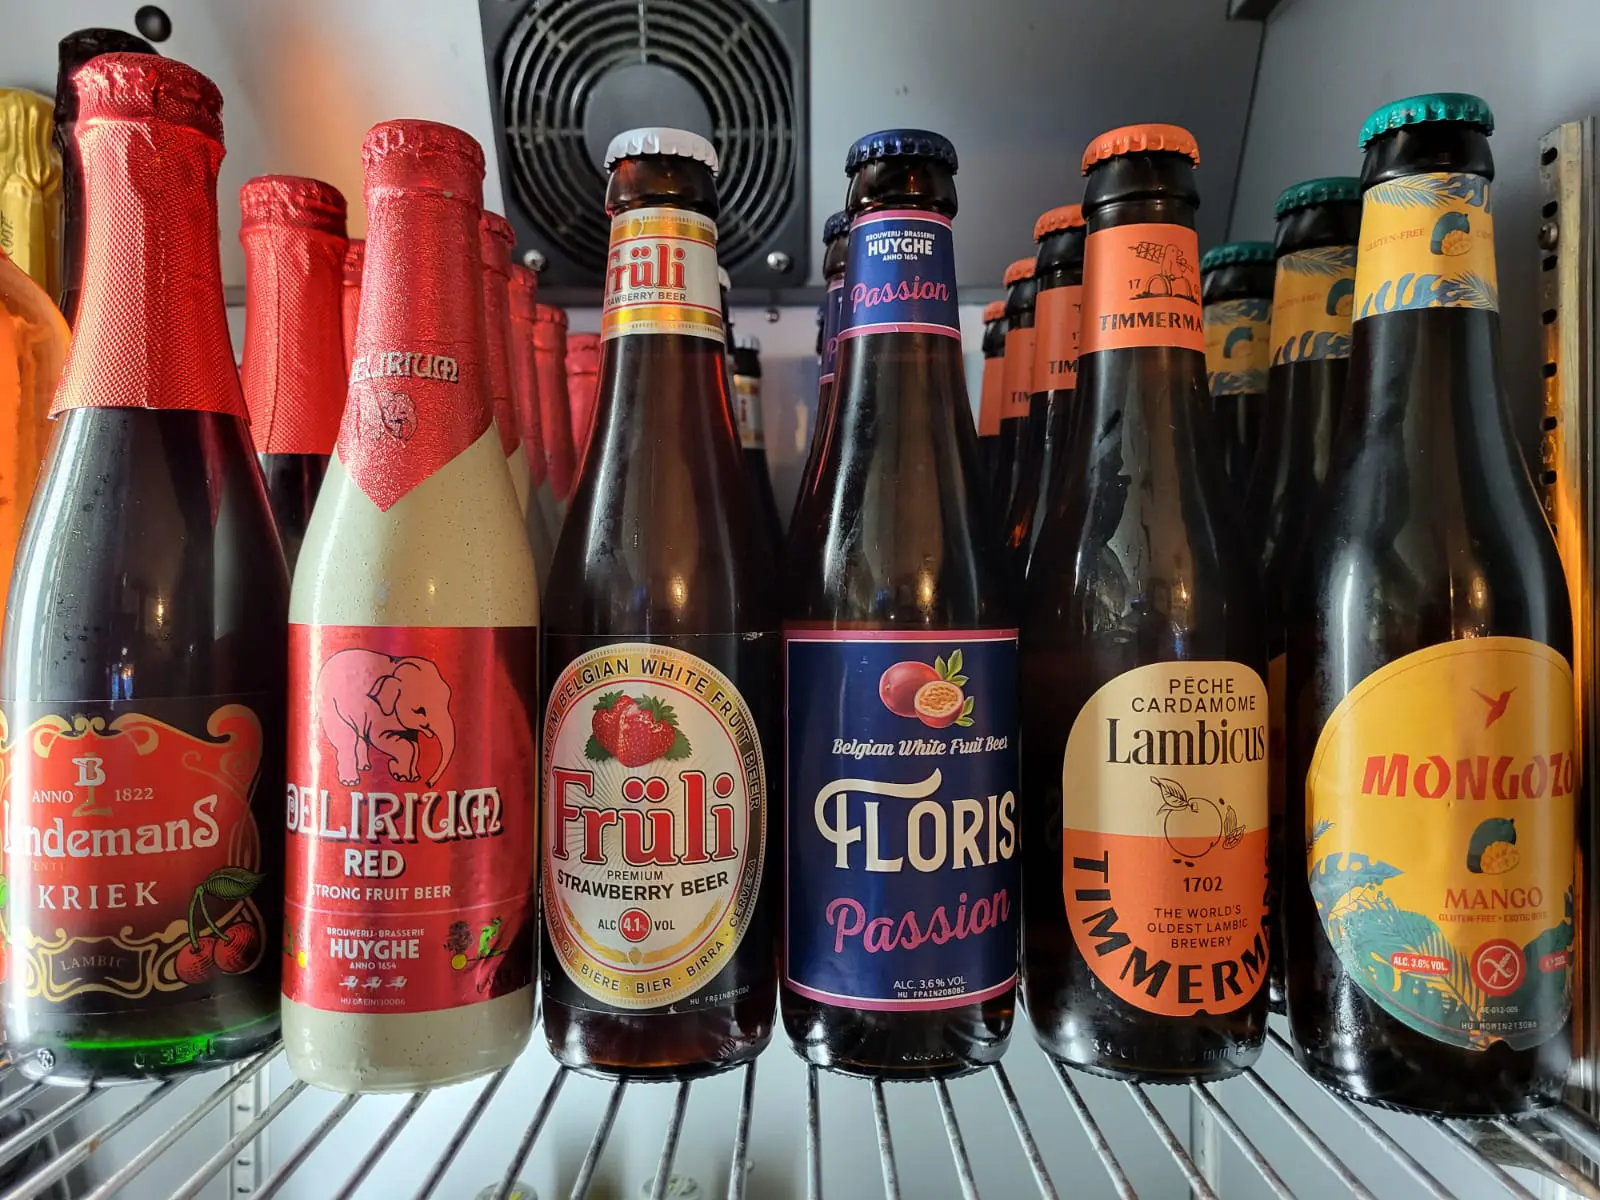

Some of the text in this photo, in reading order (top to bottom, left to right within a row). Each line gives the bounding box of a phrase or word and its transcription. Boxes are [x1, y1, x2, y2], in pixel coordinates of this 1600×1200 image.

[868, 239, 933, 256] HUYGHE
[658, 291, 687, 302] BEER
[850, 276, 949, 313] Passion
[1100, 312, 1203, 334] TIMMERMA
[1132, 696, 1256, 713] CARDAMOME
[559, 658, 629, 707] BELGIAN
[641, 659, 709, 694] WHITE
[711, 691, 750, 745] FRUIT
[744, 750, 761, 811] BEER
[1106, 718, 1265, 766] Lambicus
[832, 735, 1008, 760] Belgian White Fruit Beer
[1362, 752, 1575, 800] MONGOZO
[32, 790, 74, 804] ANNO
[115, 787, 154, 802] 1822
[286, 783, 503, 842] DELIRIUM
[552, 766, 739, 867] Früli
[814, 768, 1016, 873] FLORIS
[4, 795, 220, 858] Lndemans
[344, 848, 405, 878] RED
[557, 869, 730, 901] STRAWBERRY BEER
[607, 870, 664, 881] PREMIUM
[1184, 877, 1223, 892] 1702
[38, 881, 159, 910] KRIEK
[366, 887, 408, 900] FRUIT
[414, 885, 452, 900] BEER
[1444, 886, 1542, 910] MANGO
[826, 889, 1010, 953] Passion
[1154, 905, 1241, 919] THE WORLD'S
[598, 919, 617, 931] ALC
[654, 919, 676, 931] VOL
[636, 977, 673, 994] BIER
[686, 940, 724, 977] BIRRA
[729, 858, 757, 928] CERVEZA
[1147, 918, 1248, 934] OLDEST LAMBIC
[329, 938, 420, 959] HUYGHE
[1171, 935, 1232, 949] BREWERY
[60, 955, 128, 972] LAMBIC
